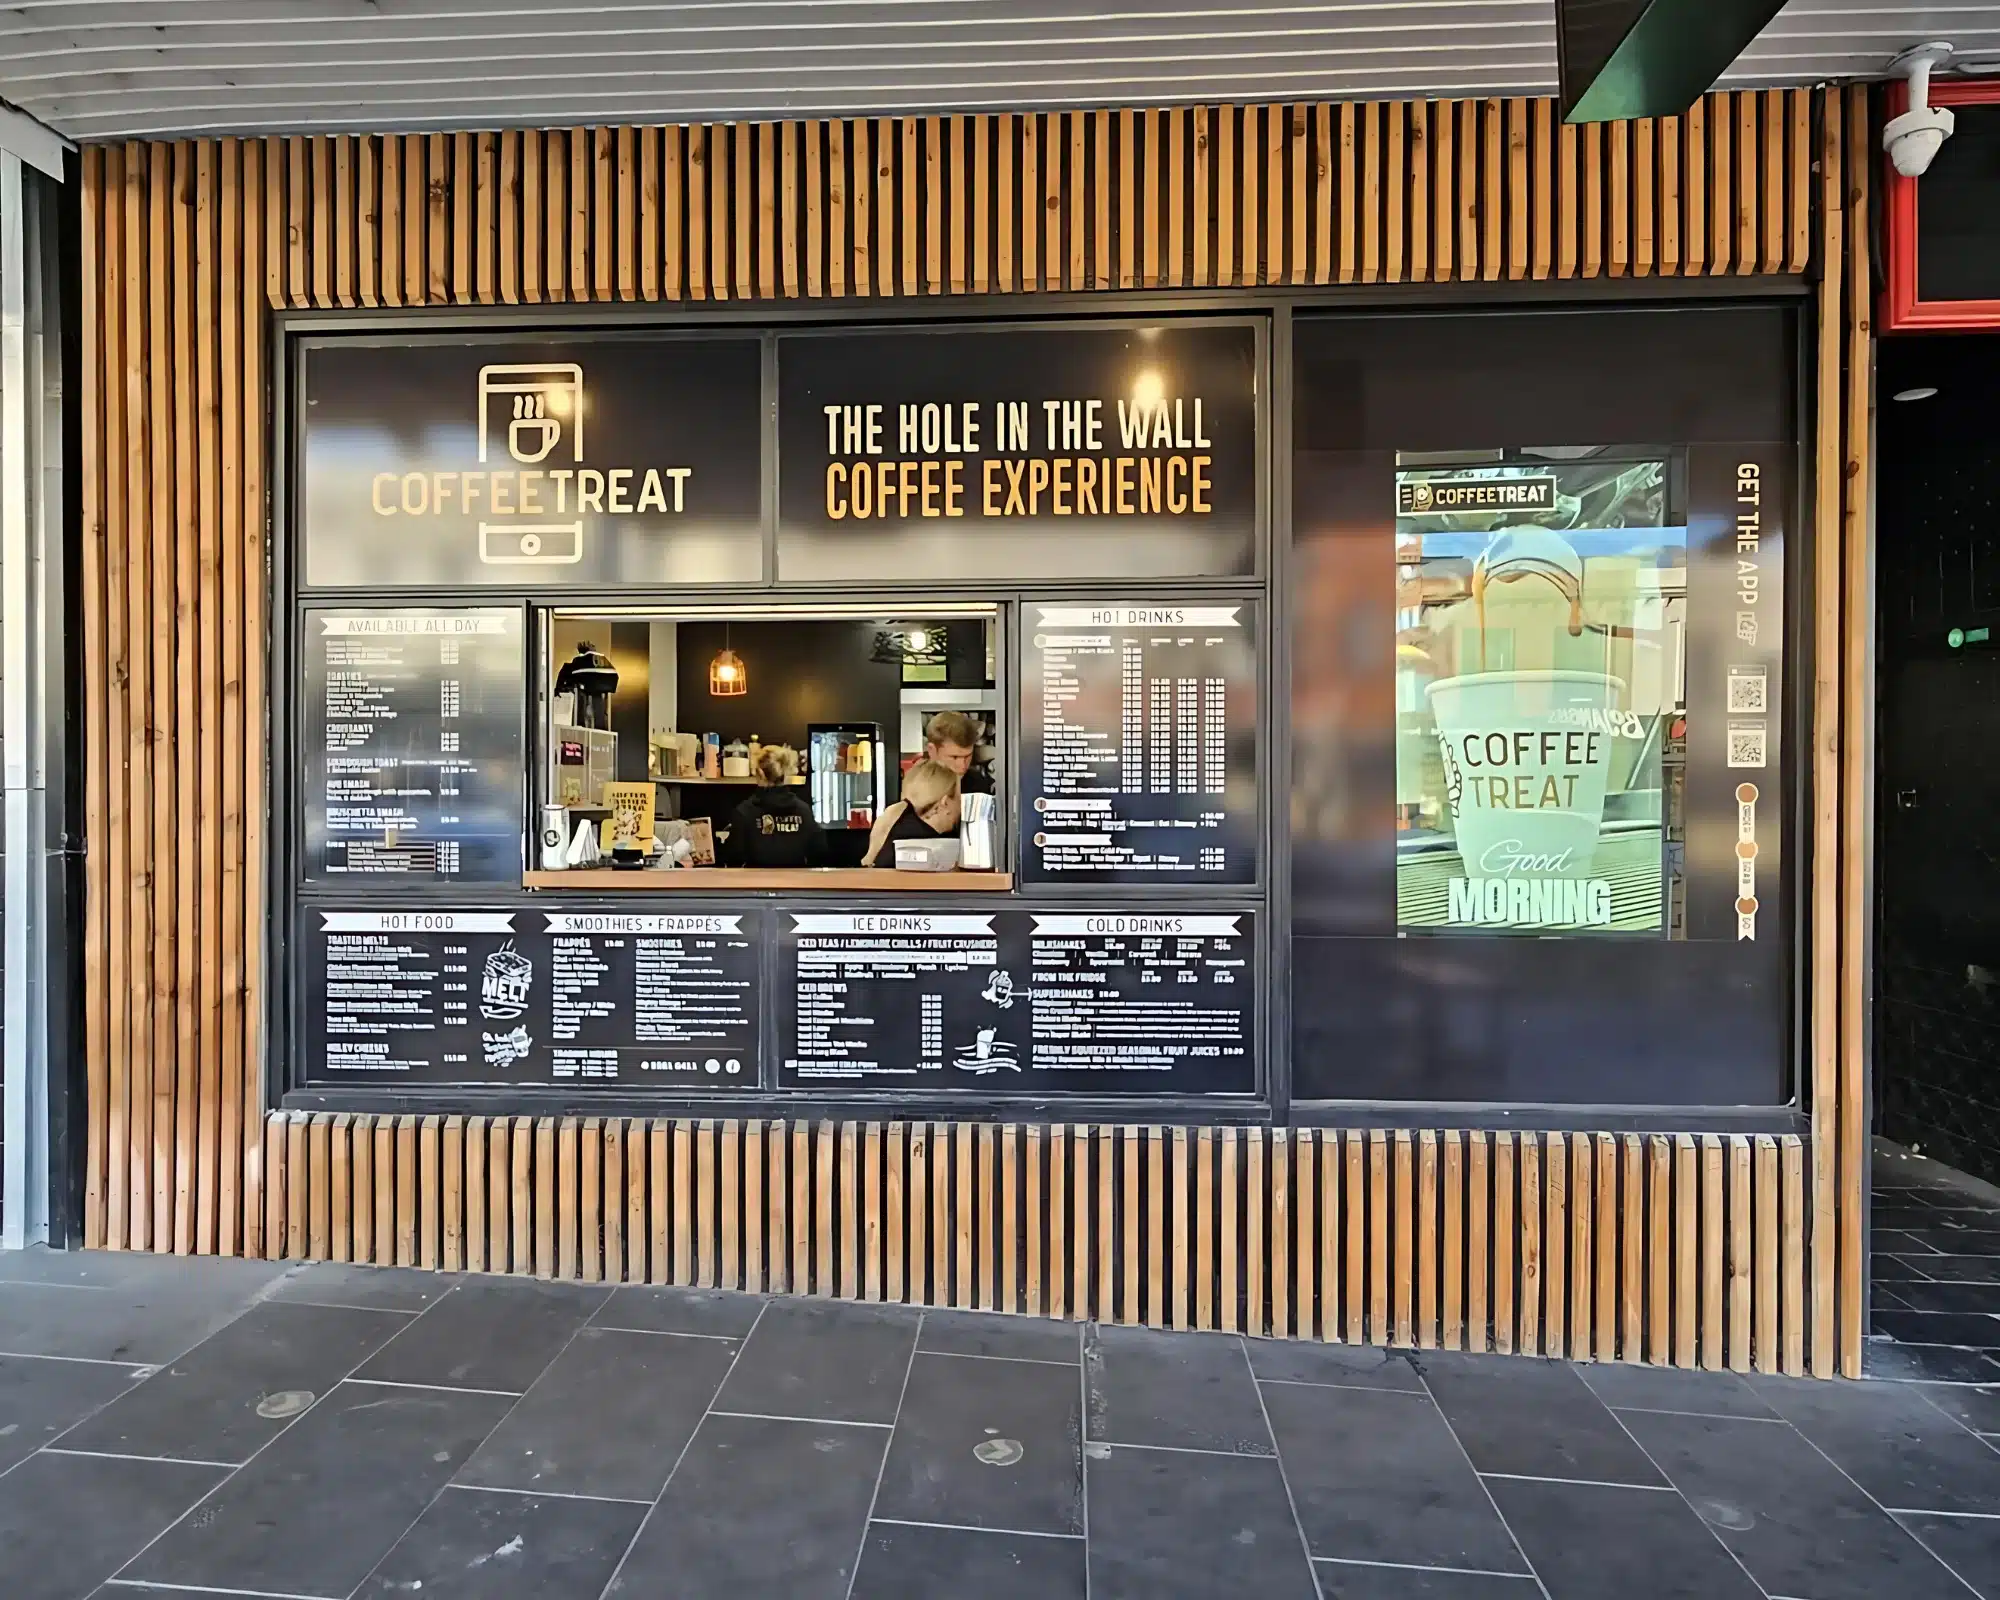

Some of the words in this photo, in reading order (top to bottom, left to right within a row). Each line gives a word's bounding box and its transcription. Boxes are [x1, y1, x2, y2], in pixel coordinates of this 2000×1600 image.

[824, 405, 883, 455] THE
[899, 403, 980, 454] HOLE
[996, 401, 1028, 452] IN
[1043, 400, 1103, 450] THE
[1117, 398, 1211, 449] WALL
[371, 468, 692, 516] COFFEETREAT
[826, 460, 964, 520] COFFEE
[982, 456, 1212, 516] EXPERIENCE
[1436, 484, 1548, 505] COFFEETREAT
[1737, 463, 1760, 506] GET
[1737, 511, 1760, 554] THE
[1737, 560, 1759, 605] APP
[348, 619, 418, 633] AVAILABLE
[425, 619, 452, 632] ALL
[454, 619, 481, 632] DAY
[1092, 610, 1120, 624] HOT
[1128, 610, 1185, 624] DRINKS
[1463, 731, 1601, 767] COFFEE
[1468, 774, 1579, 809] TREAT
[1480, 838, 1573, 882] Good
[1448, 877, 1611, 924] MORNING
[381, 915, 408, 929] HOT
[415, 915, 454, 929] FOOD
[565, 917, 643, 931] SMOOTHIES
[658, 915, 722, 932] FRAPPÉS
[853, 917, 875, 931] ICE
[879, 917, 932, 931] DRINKS
[1087, 918, 1125, 932] COLD
[1129, 918, 1183, 932] DRINKS
